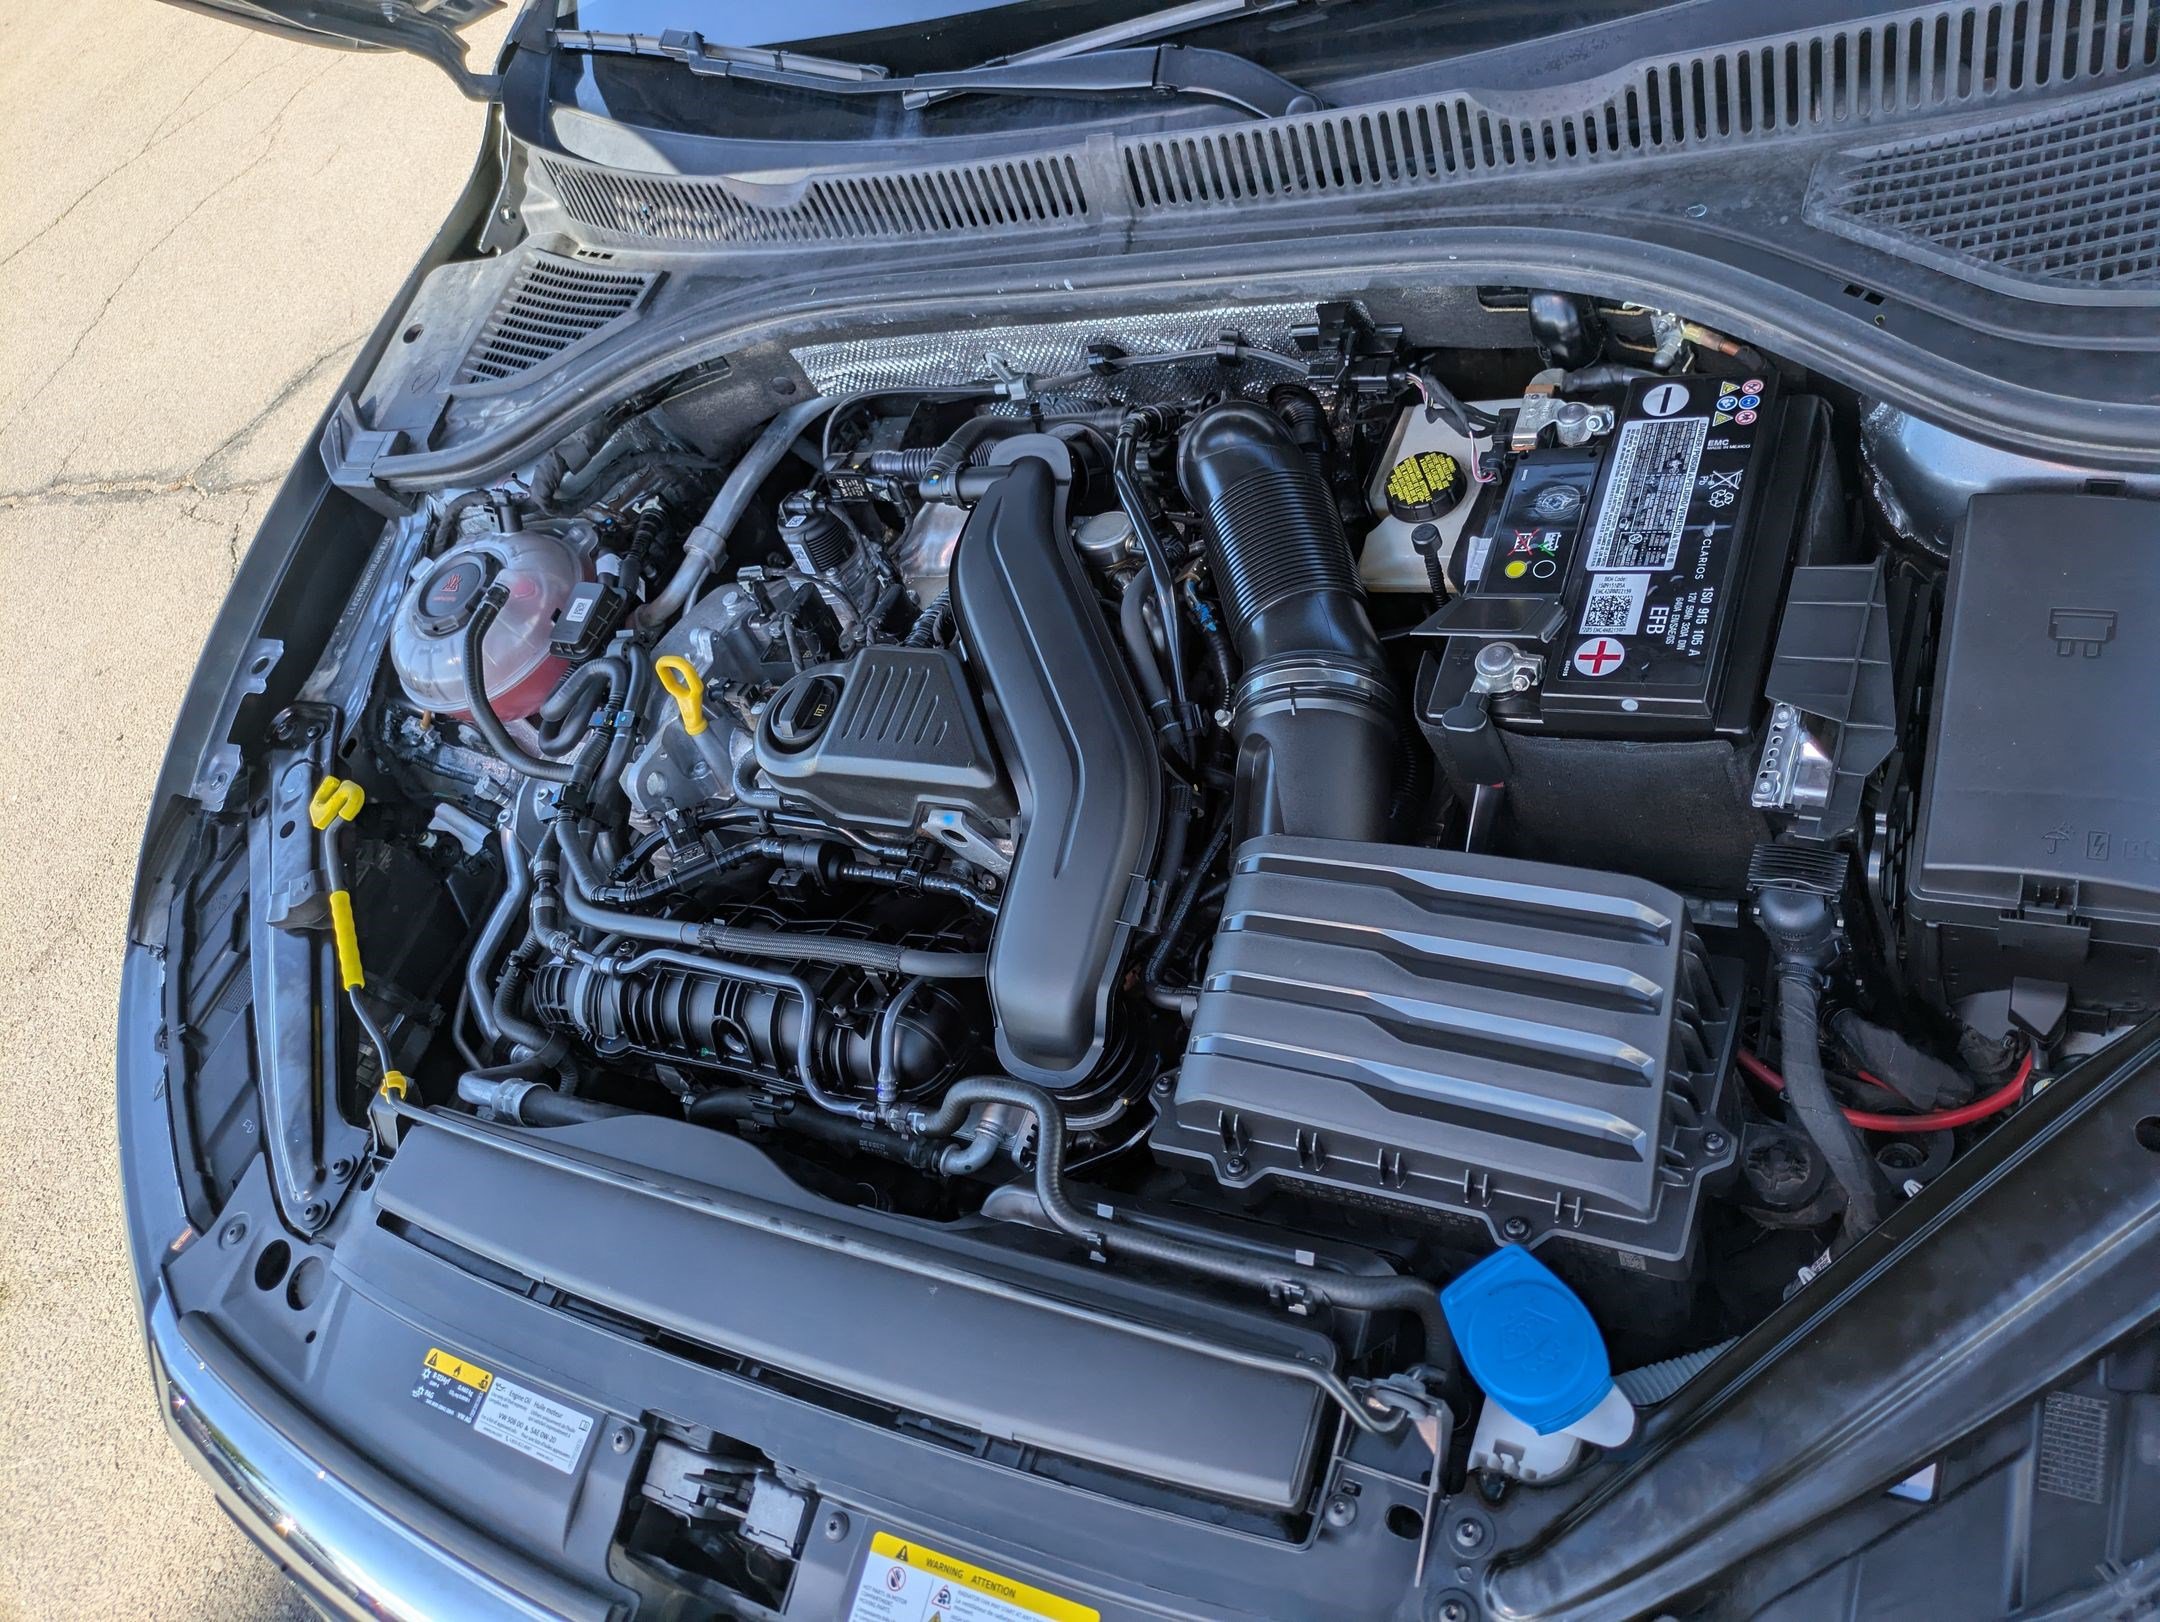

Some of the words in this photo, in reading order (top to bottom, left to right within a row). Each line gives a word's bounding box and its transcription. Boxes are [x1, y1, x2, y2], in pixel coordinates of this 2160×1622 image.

[1707, 439, 1730, 447] EMC
[1698, 475, 1709, 486] Pb
[1694, 538, 1712, 580] CLARIOS
[1673, 596, 1685, 612] 640A
[1687, 591, 1698, 603] 12V
[1646, 606, 1670, 635] EFB
[1695, 608, 1710, 625] 915
[1679, 621, 1691, 638] 320A
[1690, 629, 1704, 646] 105
[1676, 639, 1687, 651] DIN
[1688, 649, 1701, 657] A
[509, 1390, 525, 1403] Engine
[524, 1397, 532, 1405] Oil
[534, 1402, 547, 1411] Huile
[546, 1408, 563, 1419] moteur
[499, 1413, 508, 1421] VW
[507, 1417, 517, 1426] 508
[516, 1421, 525, 1429] 00
[530, 1427, 541, 1437] SAE
[540, 1432, 557, 1444] 0W-20
[926, 1558, 965, 1579] WARNING
[971, 1575, 1018, 1598] ATTENTION
